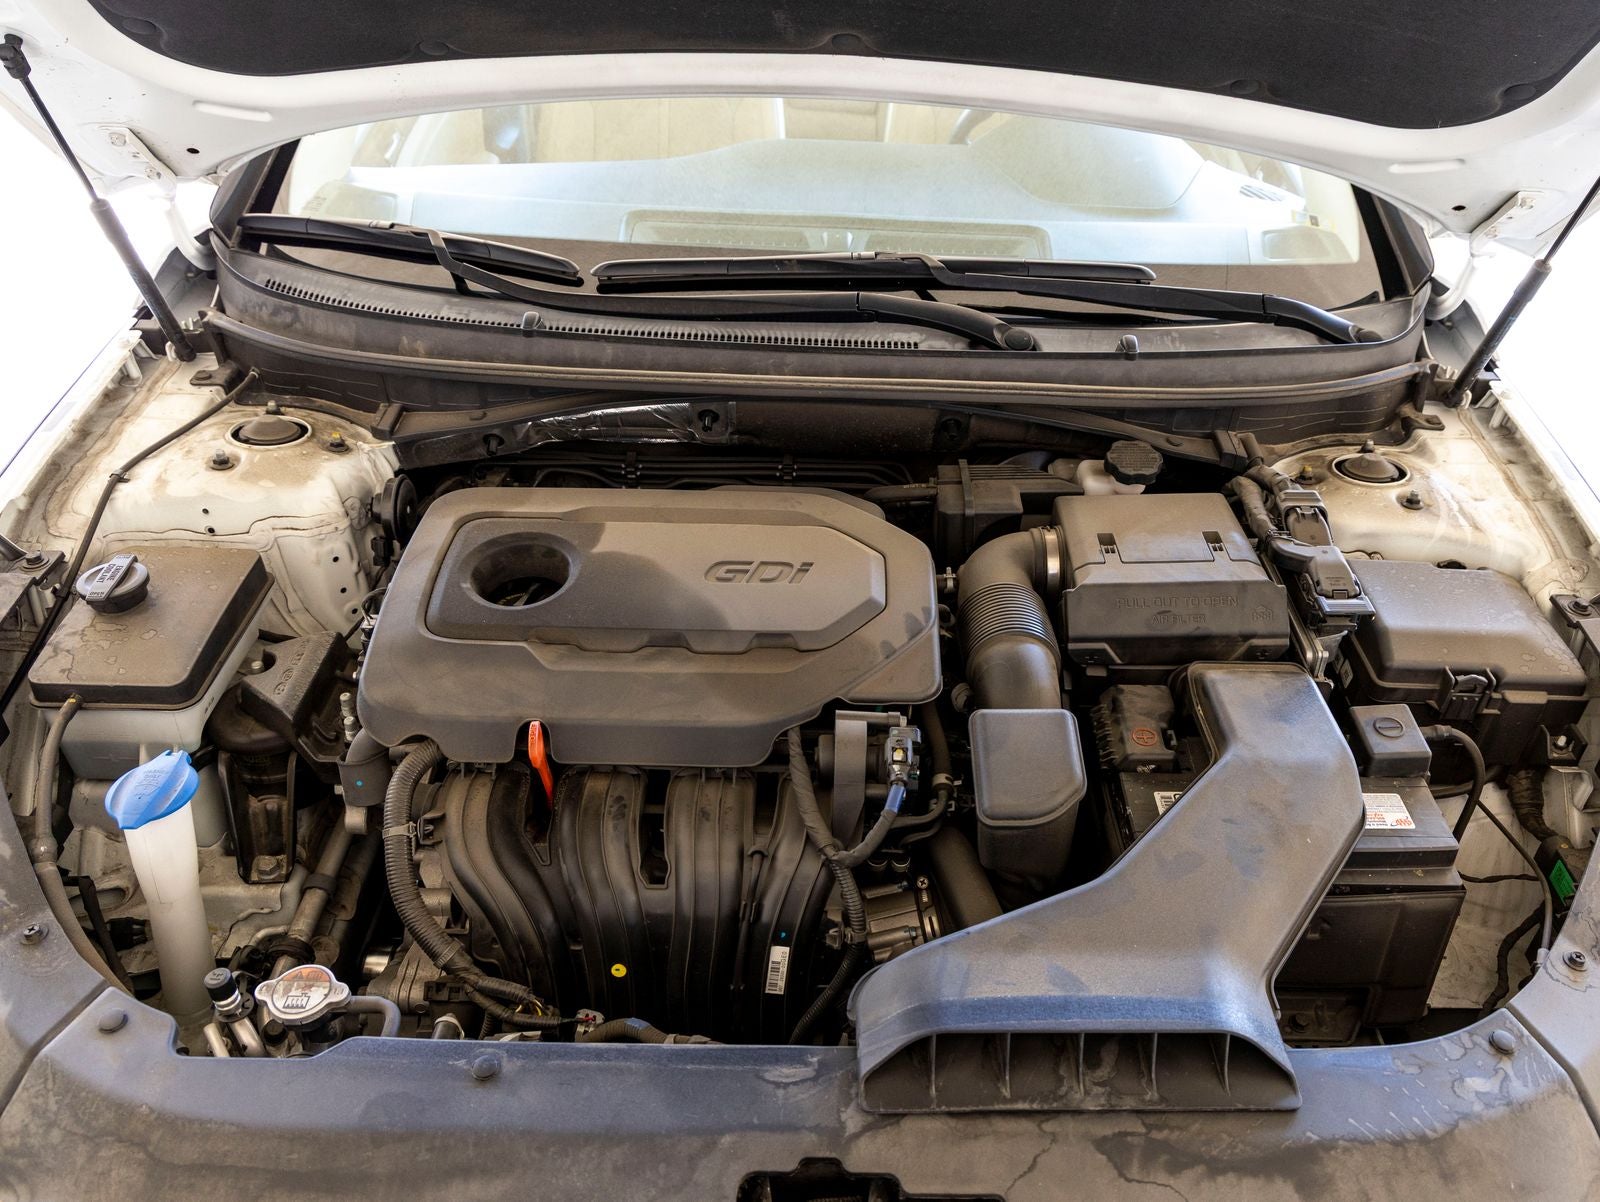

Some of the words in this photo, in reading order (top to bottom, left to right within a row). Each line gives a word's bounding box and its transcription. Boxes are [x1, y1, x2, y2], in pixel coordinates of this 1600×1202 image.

[96, 563, 116, 583] COOLANT
[106, 565, 124, 581] ENGINE
[703, 559, 815, 585] GDi
[1116, 596, 1151, 609] PULL
[1153, 596, 1178, 609] OUT
[1183, 596, 1200, 609] TO
[1203, 595, 1240, 609] OPEN
[1172, 613, 1208, 625] FILTER
